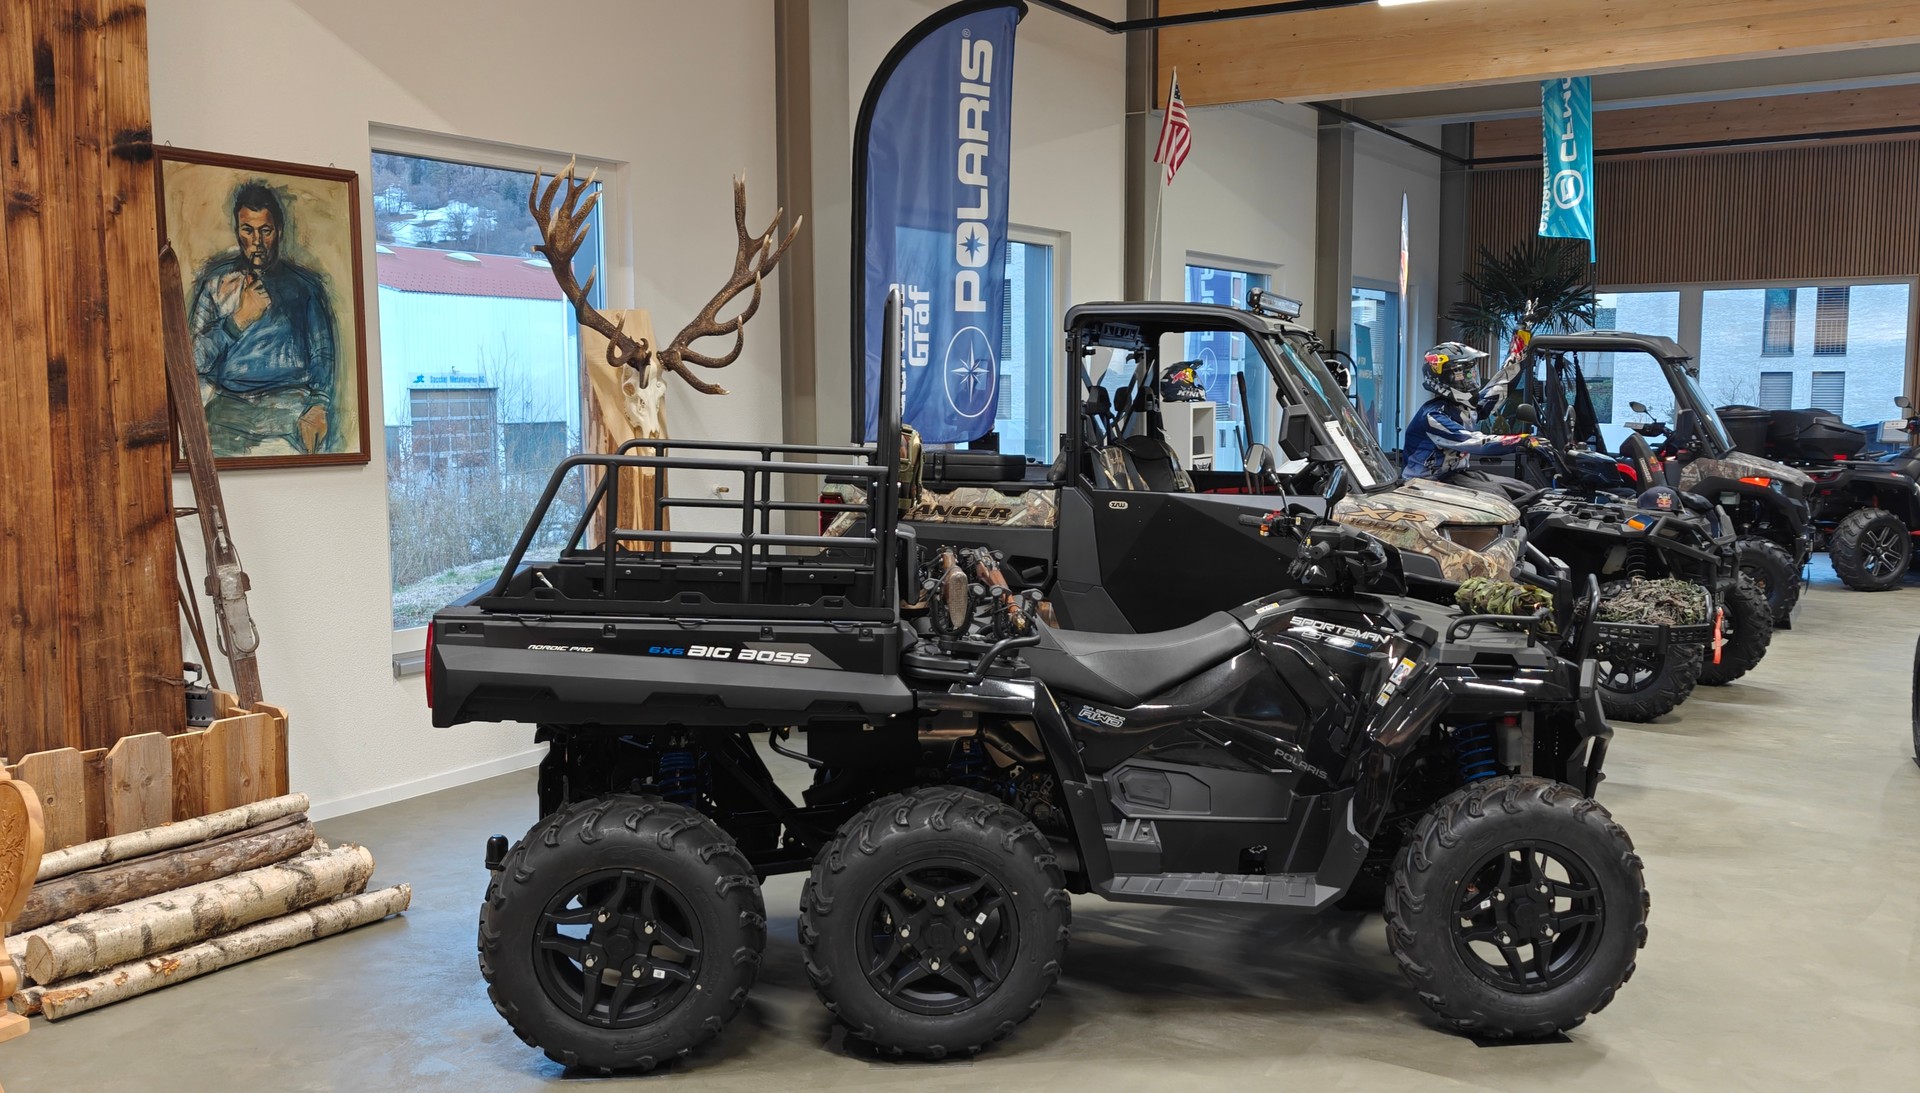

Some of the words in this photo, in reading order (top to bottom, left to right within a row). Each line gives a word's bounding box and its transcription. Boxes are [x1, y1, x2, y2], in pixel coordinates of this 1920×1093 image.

[954, 38, 994, 313] POLARIS
[907, 283, 931, 368] Graf
[907, 503, 1013, 521] ANGER
[1341, 505, 1427, 522] XP
[1289, 615, 1391, 644] SPORTSMAN
[528, 644, 568, 652] NORDIC
[687, 645, 733, 659] BIG
[737, 649, 812, 664] BOSS
[1078, 708, 1124, 728] AWD
[1274, 747, 1329, 780] POLARIS
